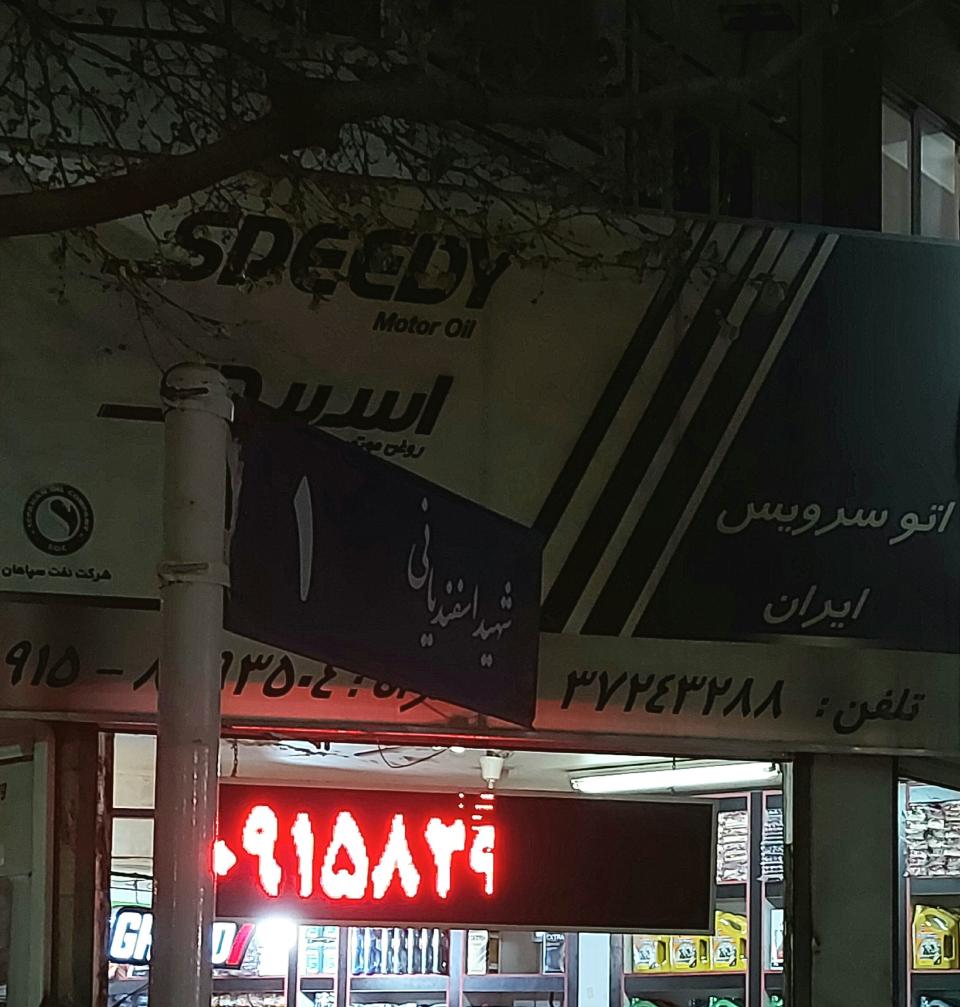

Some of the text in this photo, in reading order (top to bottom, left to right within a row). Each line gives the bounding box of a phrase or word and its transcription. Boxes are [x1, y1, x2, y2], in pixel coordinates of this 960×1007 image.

[103, 209, 513, 310] SPEEDY
[372, 311, 477, 340] Motor Oil
[715, 499, 957, 546] اتو سرویس
[1, 563, 112, 582] شرکت نفت سپاهان
[471, 579, 513, 669] شهید
[762, 584, 872, 630] ایران
